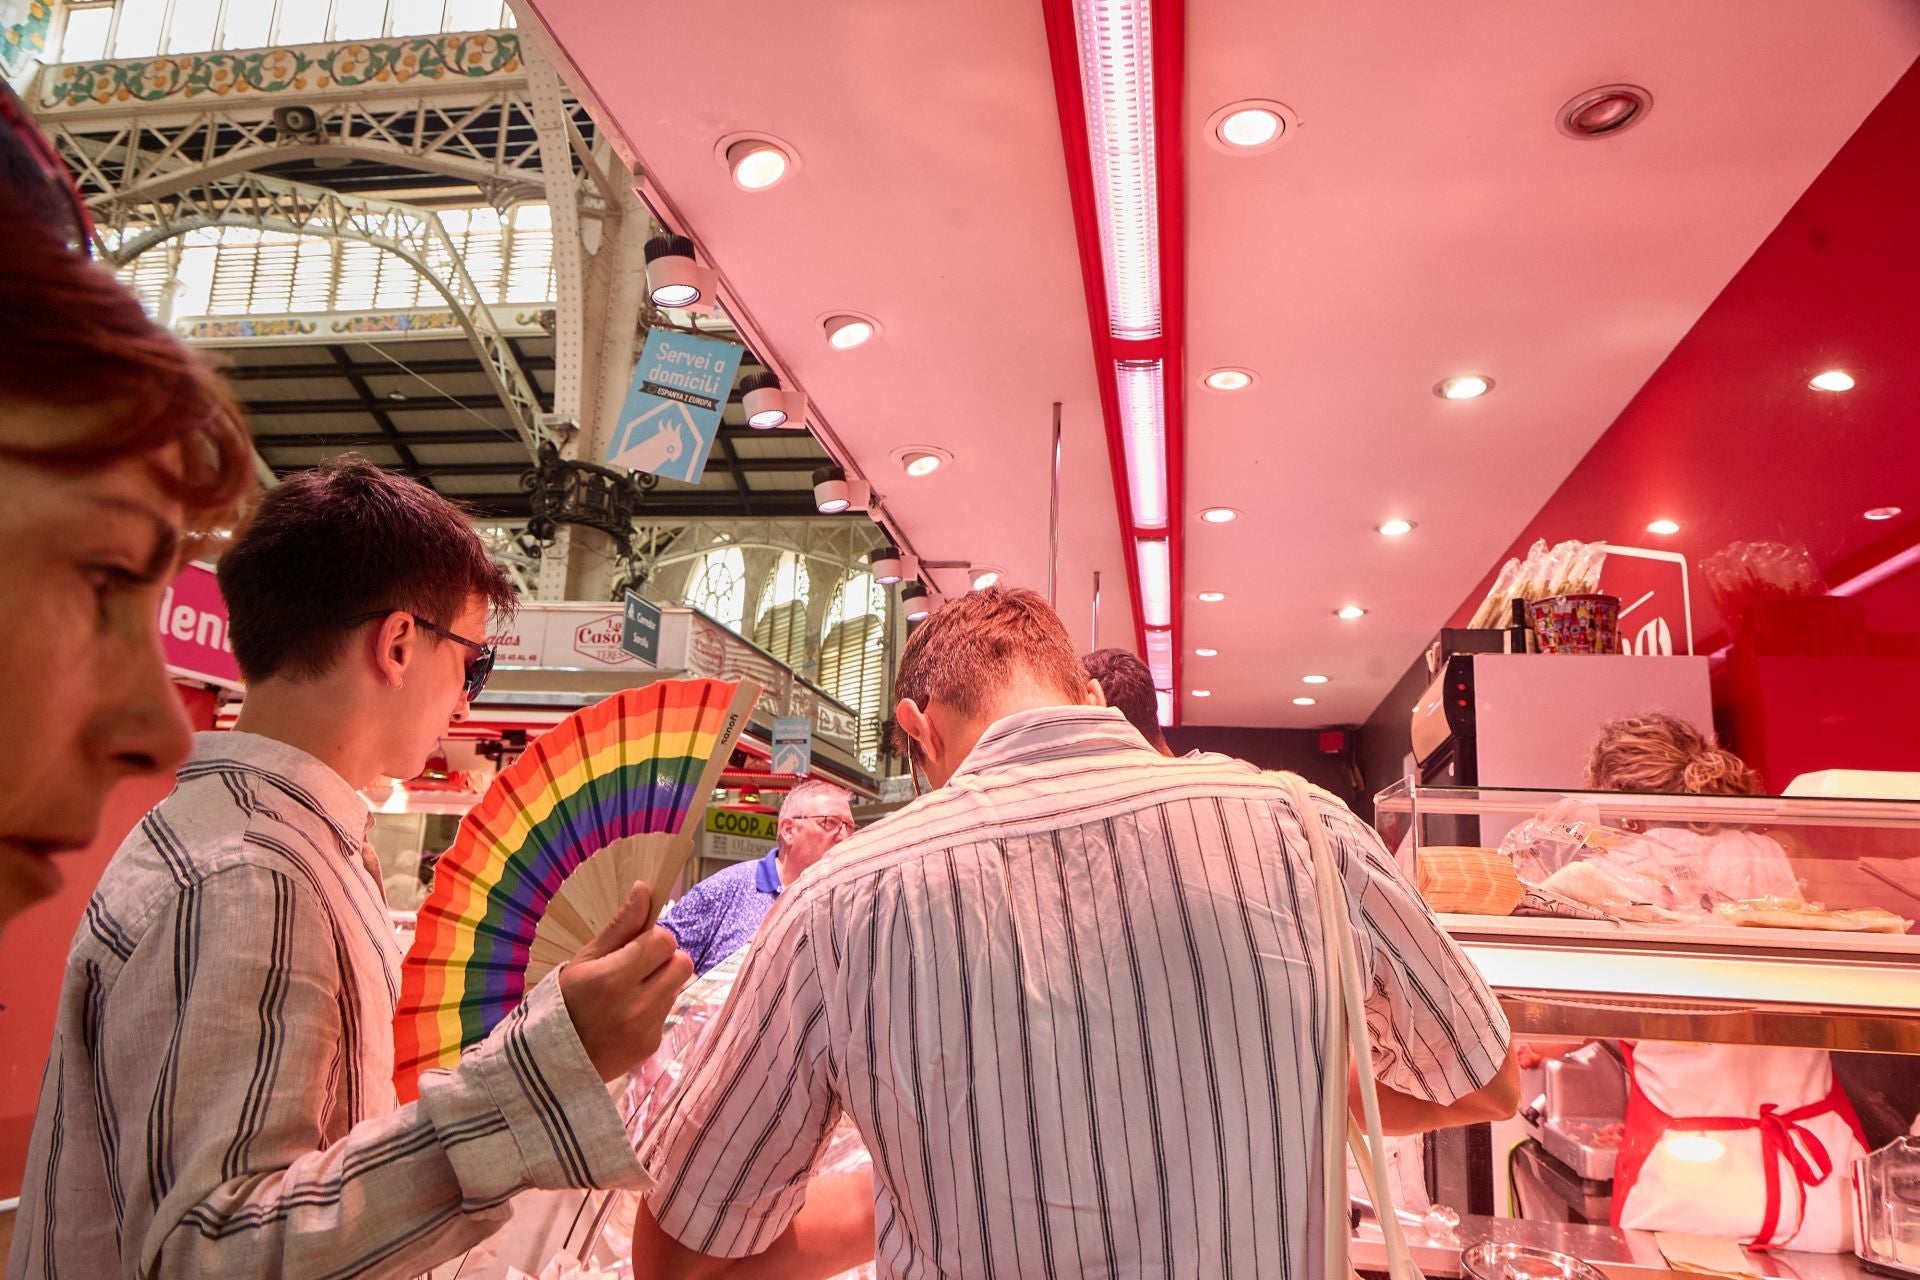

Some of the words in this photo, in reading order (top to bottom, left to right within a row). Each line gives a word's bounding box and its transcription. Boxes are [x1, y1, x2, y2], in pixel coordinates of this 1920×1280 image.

[656, 342, 713, 370] Servei
[714, 360, 726, 374] a
[649, 364, 721, 394] domicili
[657, 387, 685, 401] ESPANYA
[689, 395, 713, 408] EUROPA
[721, 713, 739, 745] sanofi
[714, 812, 761, 835] COOP.
